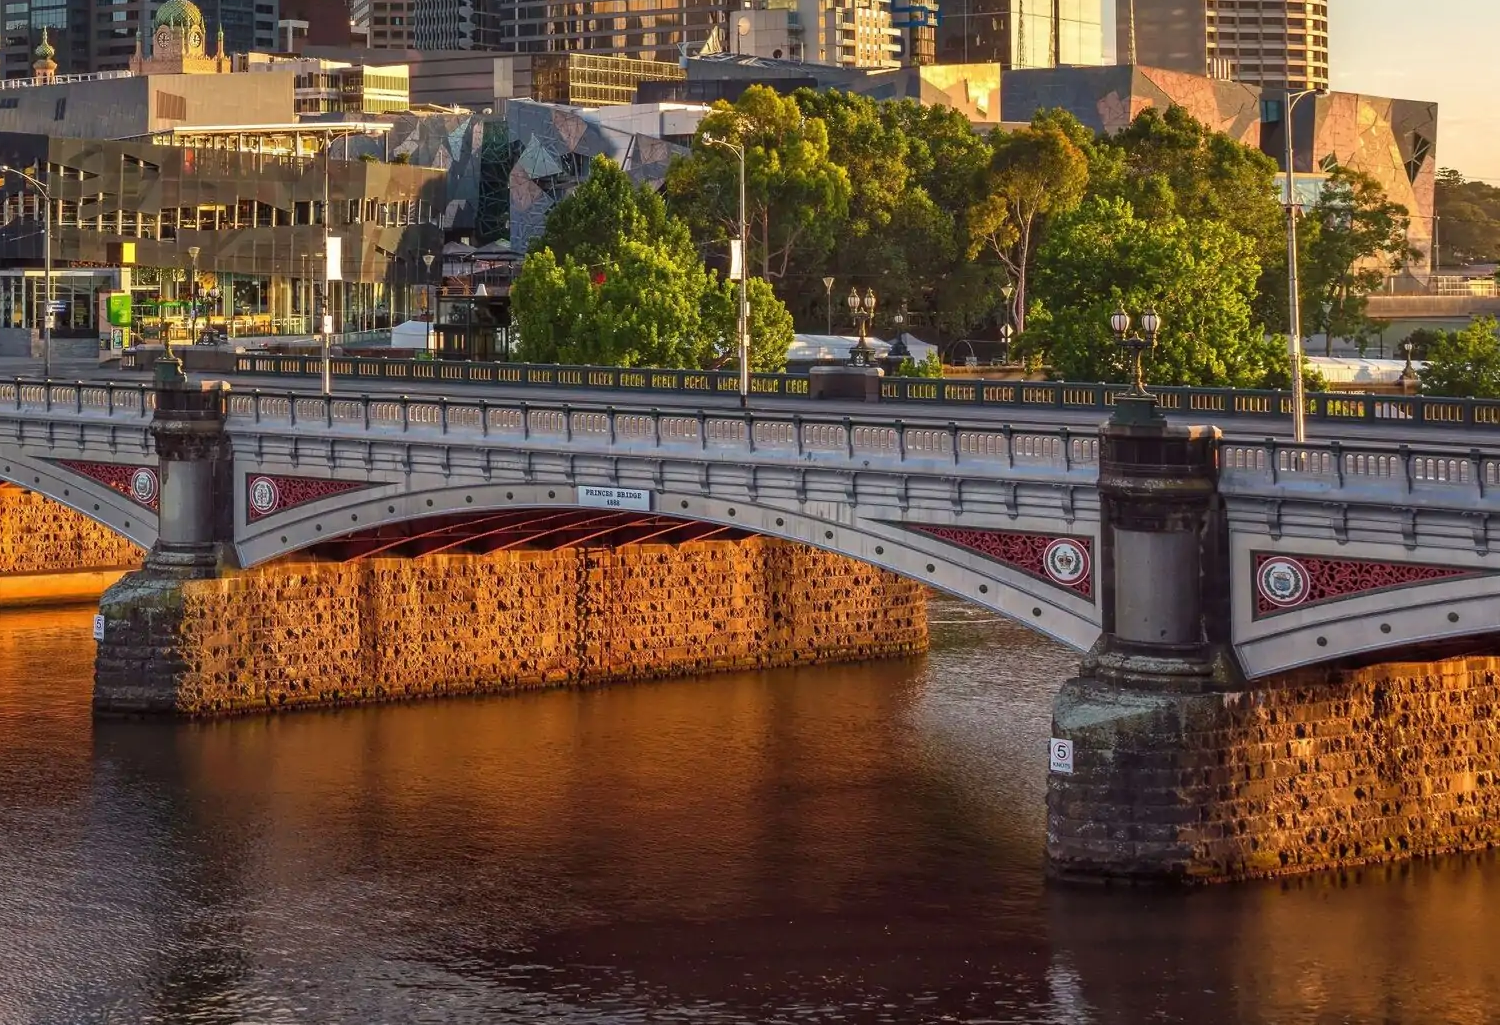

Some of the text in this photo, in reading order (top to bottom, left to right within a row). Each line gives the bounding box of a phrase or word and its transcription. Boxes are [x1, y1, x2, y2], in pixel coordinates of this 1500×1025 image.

[585, 489, 613, 497] PRINCES
[97, 619, 102, 628] 5
[1057, 745, 1066, 758] 5
